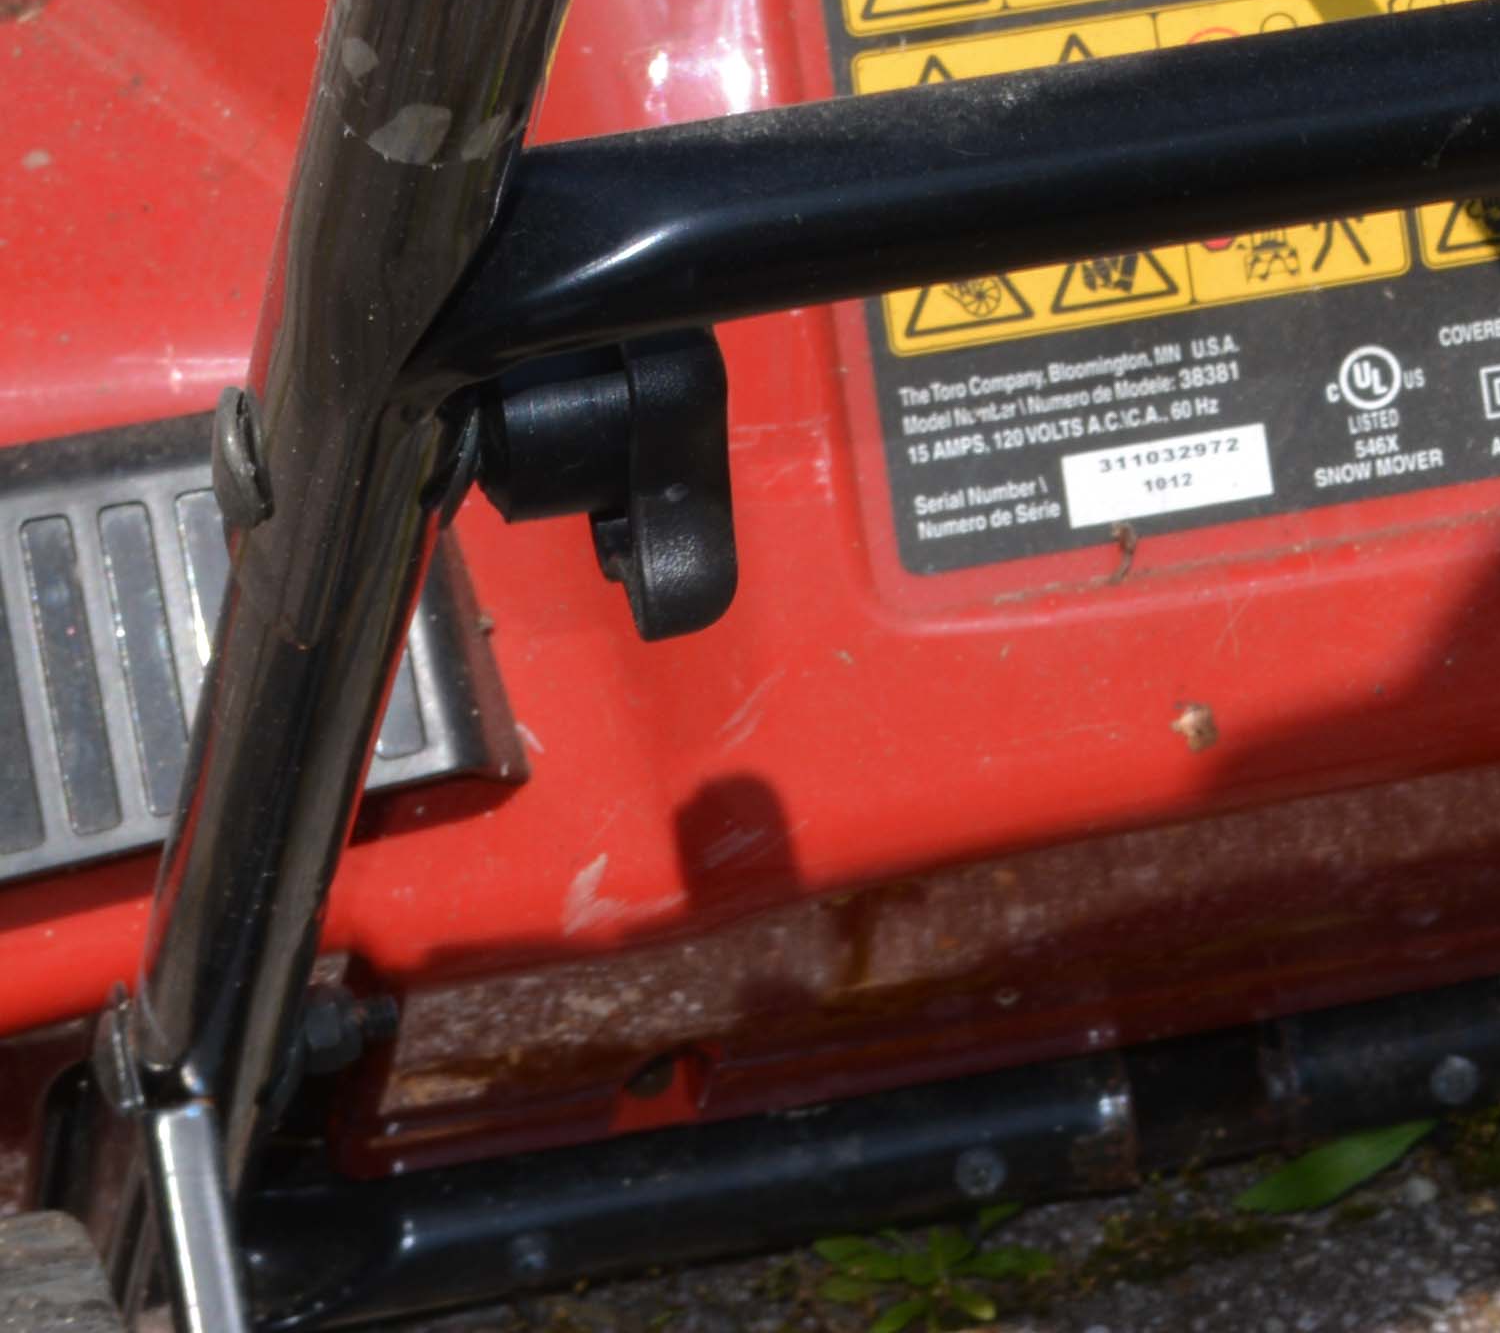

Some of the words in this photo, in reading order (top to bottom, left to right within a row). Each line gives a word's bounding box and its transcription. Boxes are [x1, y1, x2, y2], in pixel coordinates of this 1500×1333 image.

[898, 386, 930, 407] The
[930, 381, 966, 402] Toro
[1153, 343, 1181, 365] MN
[1190, 333, 1240, 359] U.S.A.
[1351, 357, 1388, 398] UL
[1402, 367, 1425, 390] US
[901, 409, 952, 435] Model
[1026, 389, 1090, 415] Numero
[1091, 384, 1113, 404] de
[1178, 359, 1240, 390] 38381
[906, 443, 929, 464] 15
[992, 427, 1025, 450] 120
[1024, 416, 1085, 444] VOLTS
[1169, 399, 1192, 420] 60
[1193, 396, 1218, 416] Hz
[1346, 407, 1400, 435] LISTED
[1098, 437, 1241, 474] 311032972
[1354, 433, 1400, 459] 546X
[1143, 472, 1192, 493] 1012
[1313, 460, 1373, 488] SNOW
[1374, 447, 1444, 477] MOVER
[914, 489, 965, 516] Serial
[967, 480, 1037, 507] Number
[919, 513, 984, 542] Numero
[989, 509, 1013, 529] de
[1014, 500, 1061, 524] Série
